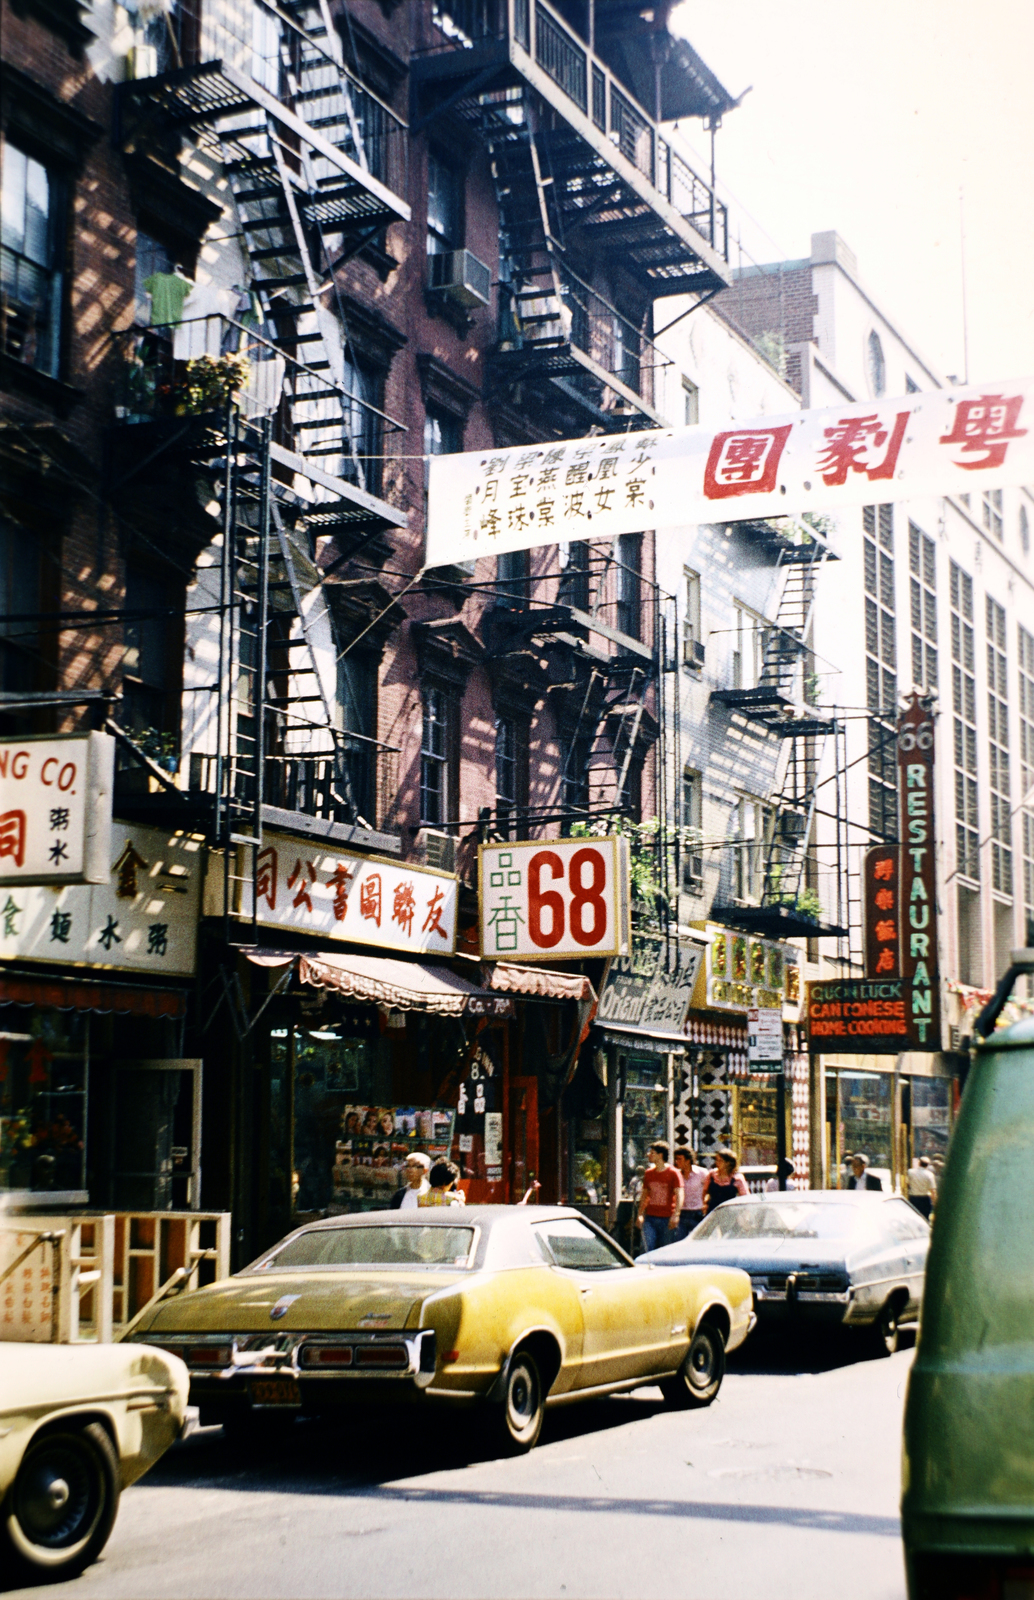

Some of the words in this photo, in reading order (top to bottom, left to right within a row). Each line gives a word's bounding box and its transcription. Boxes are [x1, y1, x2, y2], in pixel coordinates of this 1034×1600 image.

[900, 722, 933, 751] 66
[40, 756, 77, 796] CO.
[486, 852, 525, 951] 品香
[527, 847, 607, 949] 68
[906, 763, 932, 1043] RESTAURANT
[860, 984, 902, 999] LUCK
[810, 1001, 905, 1019] CANTONESE
[811, 1020, 847, 1036] HOME
[848, 1018, 907, 1036] COOKING
